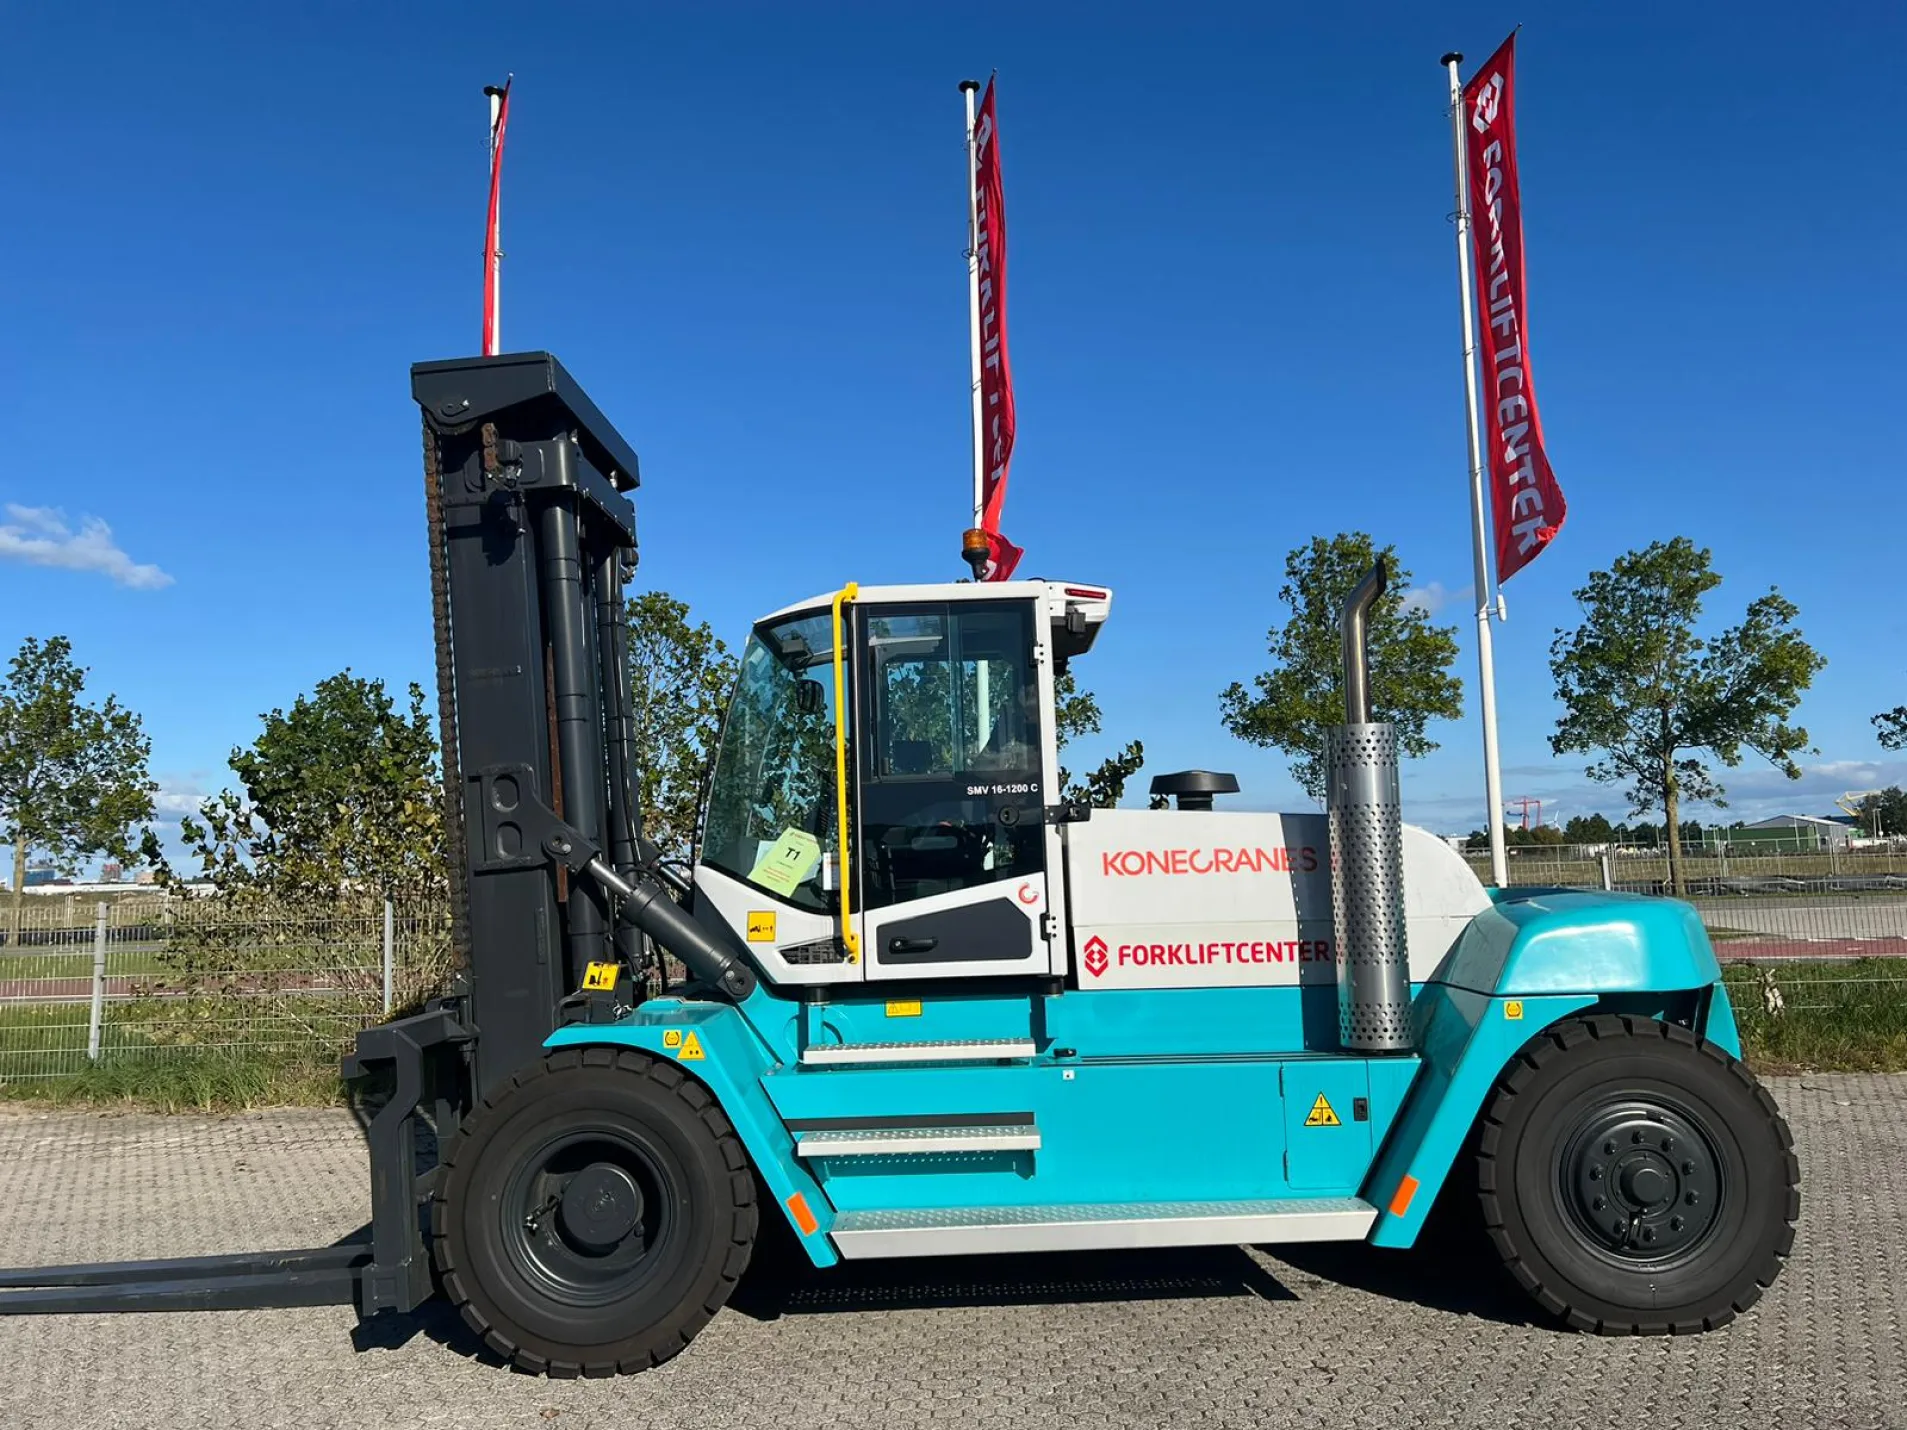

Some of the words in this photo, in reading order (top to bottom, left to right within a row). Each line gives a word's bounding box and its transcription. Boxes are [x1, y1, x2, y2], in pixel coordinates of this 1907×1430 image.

[967, 785, 989, 795] SMV
[991, 784, 1029, 794] 16-1200
[1030, 783, 1038, 792] C
[785, 846, 801, 861] T1
[1102, 846, 1318, 877] KONECRANES
[1118, 940, 1330, 966] FORKLIFTCENTER
